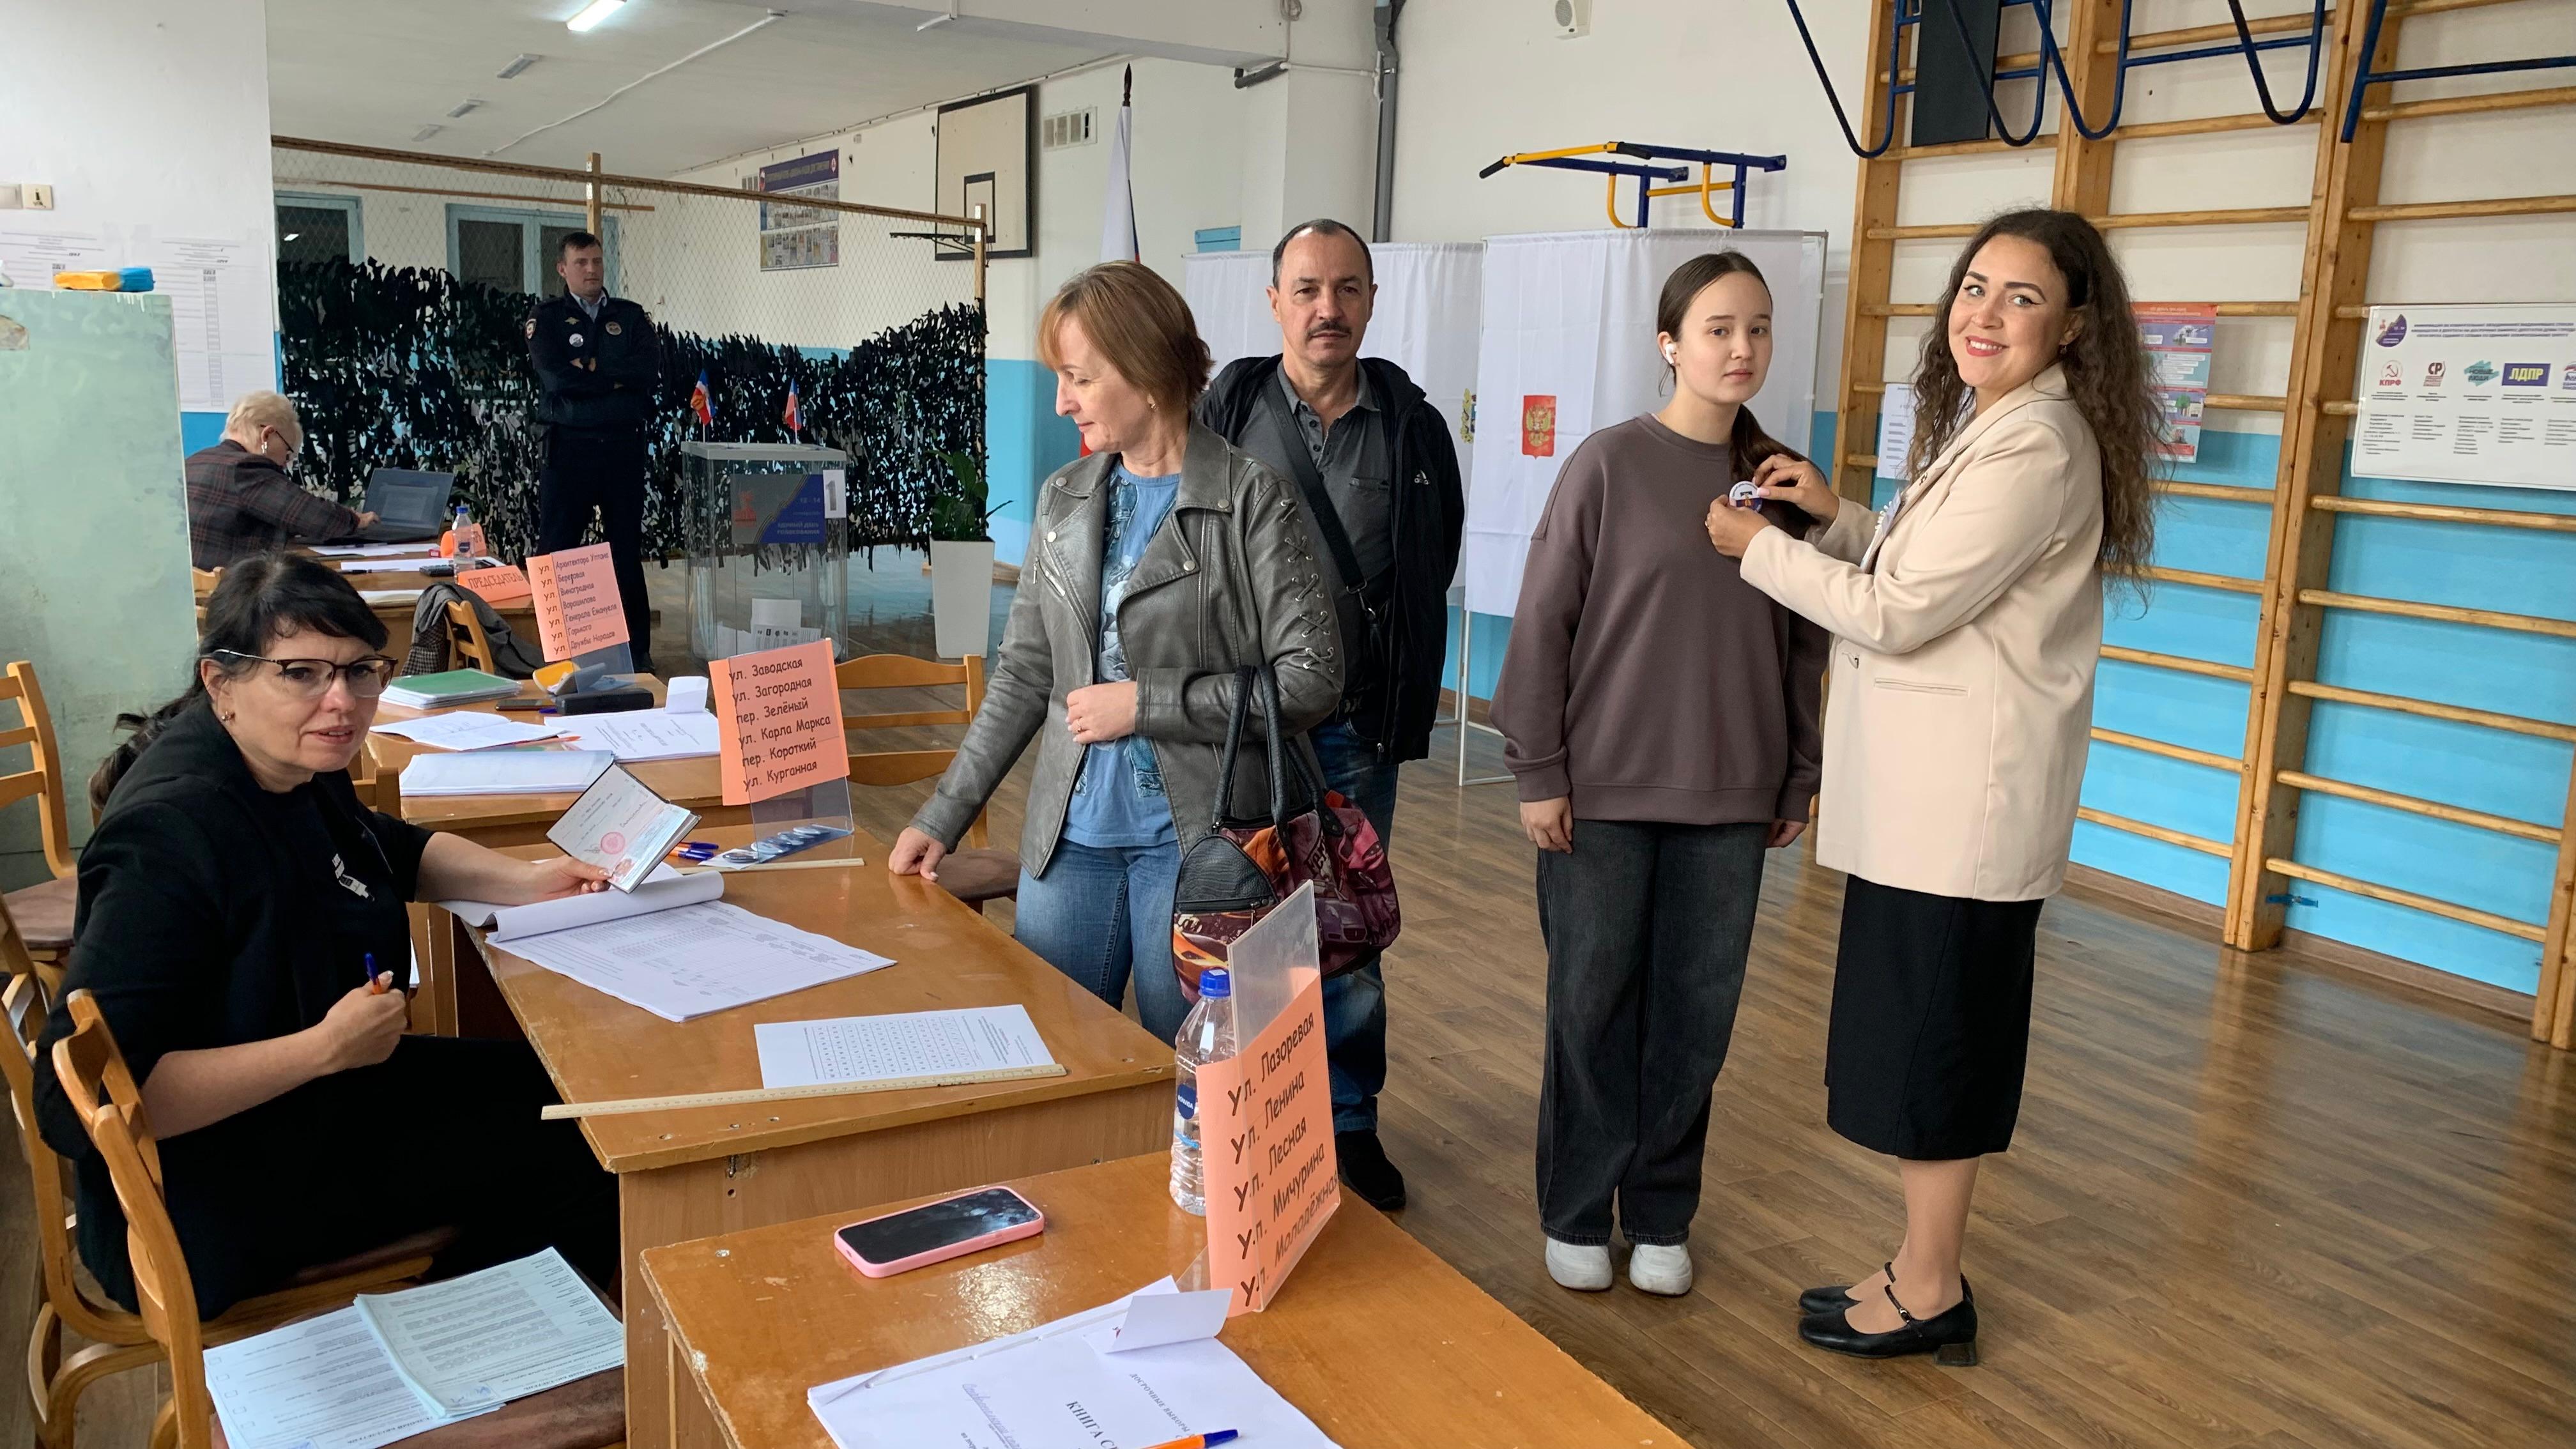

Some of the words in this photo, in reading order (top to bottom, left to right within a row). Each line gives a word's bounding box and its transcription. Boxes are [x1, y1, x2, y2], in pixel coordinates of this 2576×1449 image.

[2428, 362, 2443, 374] СР
[2509, 367, 2544, 382] ЛДПР
[825, 480, 836, 510] 1
[468, 572, 523, 589] ПРЕДСЕДАТЕЛЬ
[560, 583, 594, 596] Виноградная
[562, 596, 596, 610] Ворошилова
[565, 611, 591, 623] Генерала
[567, 624, 592, 636] Горького
[571, 637, 592, 650] Дружбы
[729, 670, 747, 685] ул.
[752, 659, 803, 677] Заводская
[732, 692, 750, 707] ул.
[755, 678, 812, 698] Загородная
[736, 712, 759, 725] пер.
[763, 697, 809, 718] Зелёный
[739, 735, 756, 749] ул.
[761, 724, 792, 741] Карла
[796, 716, 831, 735] Маркса
[742, 755, 765, 767] пер.
[769, 738, 817, 762] Короткий
[743, 777, 762, 792] ул.
[767, 761, 817, 784] Курганная
[1261, 1012, 1314, 1082] Лазоревая
[1265, 1071, 1305, 1130] Ленина
[1268, 1117, 1307, 1176] Лесная
[1273, 1143, 1325, 1222] Мичурина
[1130, 1374, 1165, 1407] ДОСРОЧНЫЕ
[1163, 1407, 1190, 1432] ВЫБОРЫ
[1066, 1400, 1104, 1439] КНИГА
